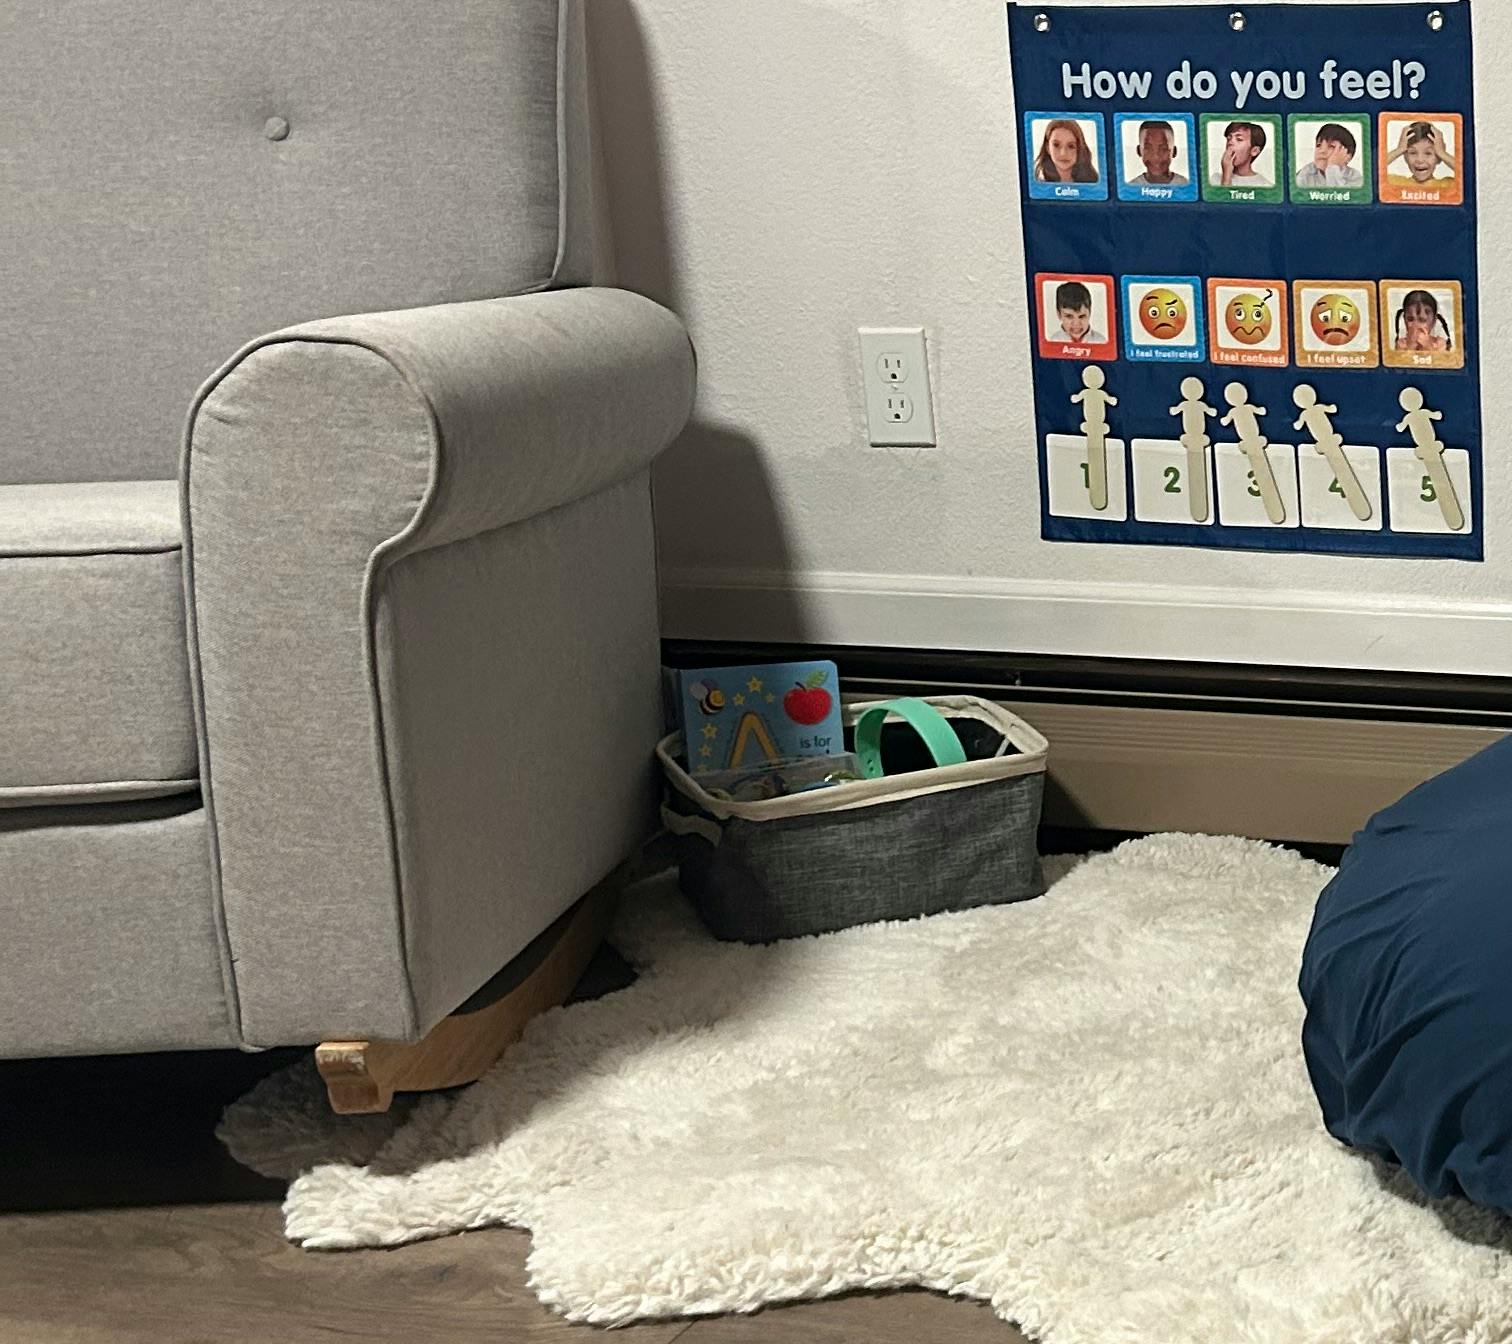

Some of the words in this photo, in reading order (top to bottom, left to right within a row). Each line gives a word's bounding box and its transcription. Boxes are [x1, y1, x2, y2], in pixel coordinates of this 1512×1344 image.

[1062, 62, 1152, 99] How
[1166, 60, 1218, 99] do
[1231, 71, 1306, 109] you
[1319, 59, 1426, 99] feel?
[1055, 187, 1080, 197] Calm
[1141, 187, 1173, 199] Happy
[1230, 190, 1255, 201] Tired
[1309, 191, 1350, 201] Worried
[1401, 190, 1440, 201] Excited
[1062, 345, 1091, 357] Angry
[1136, 350, 1153, 358] feel
[1154, 350, 1199, 359] frustrated
[1219, 352, 1239, 362] feel
[1241, 354, 1285, 364] confused
[1313, 353, 1334, 363] feel
[1336, 354, 1366, 365] upset
[1412, 355, 1432, 365] Sad
[1080, 463, 1090, 489] 1
[1164, 467, 1181, 493] 2
[1247, 470, 1262, 497] 3
[1328, 477, 1346, 499] 4
[1420, 476, 1437, 502] 5
[800, 737, 811, 748] is
[814, 735, 831, 748] for
